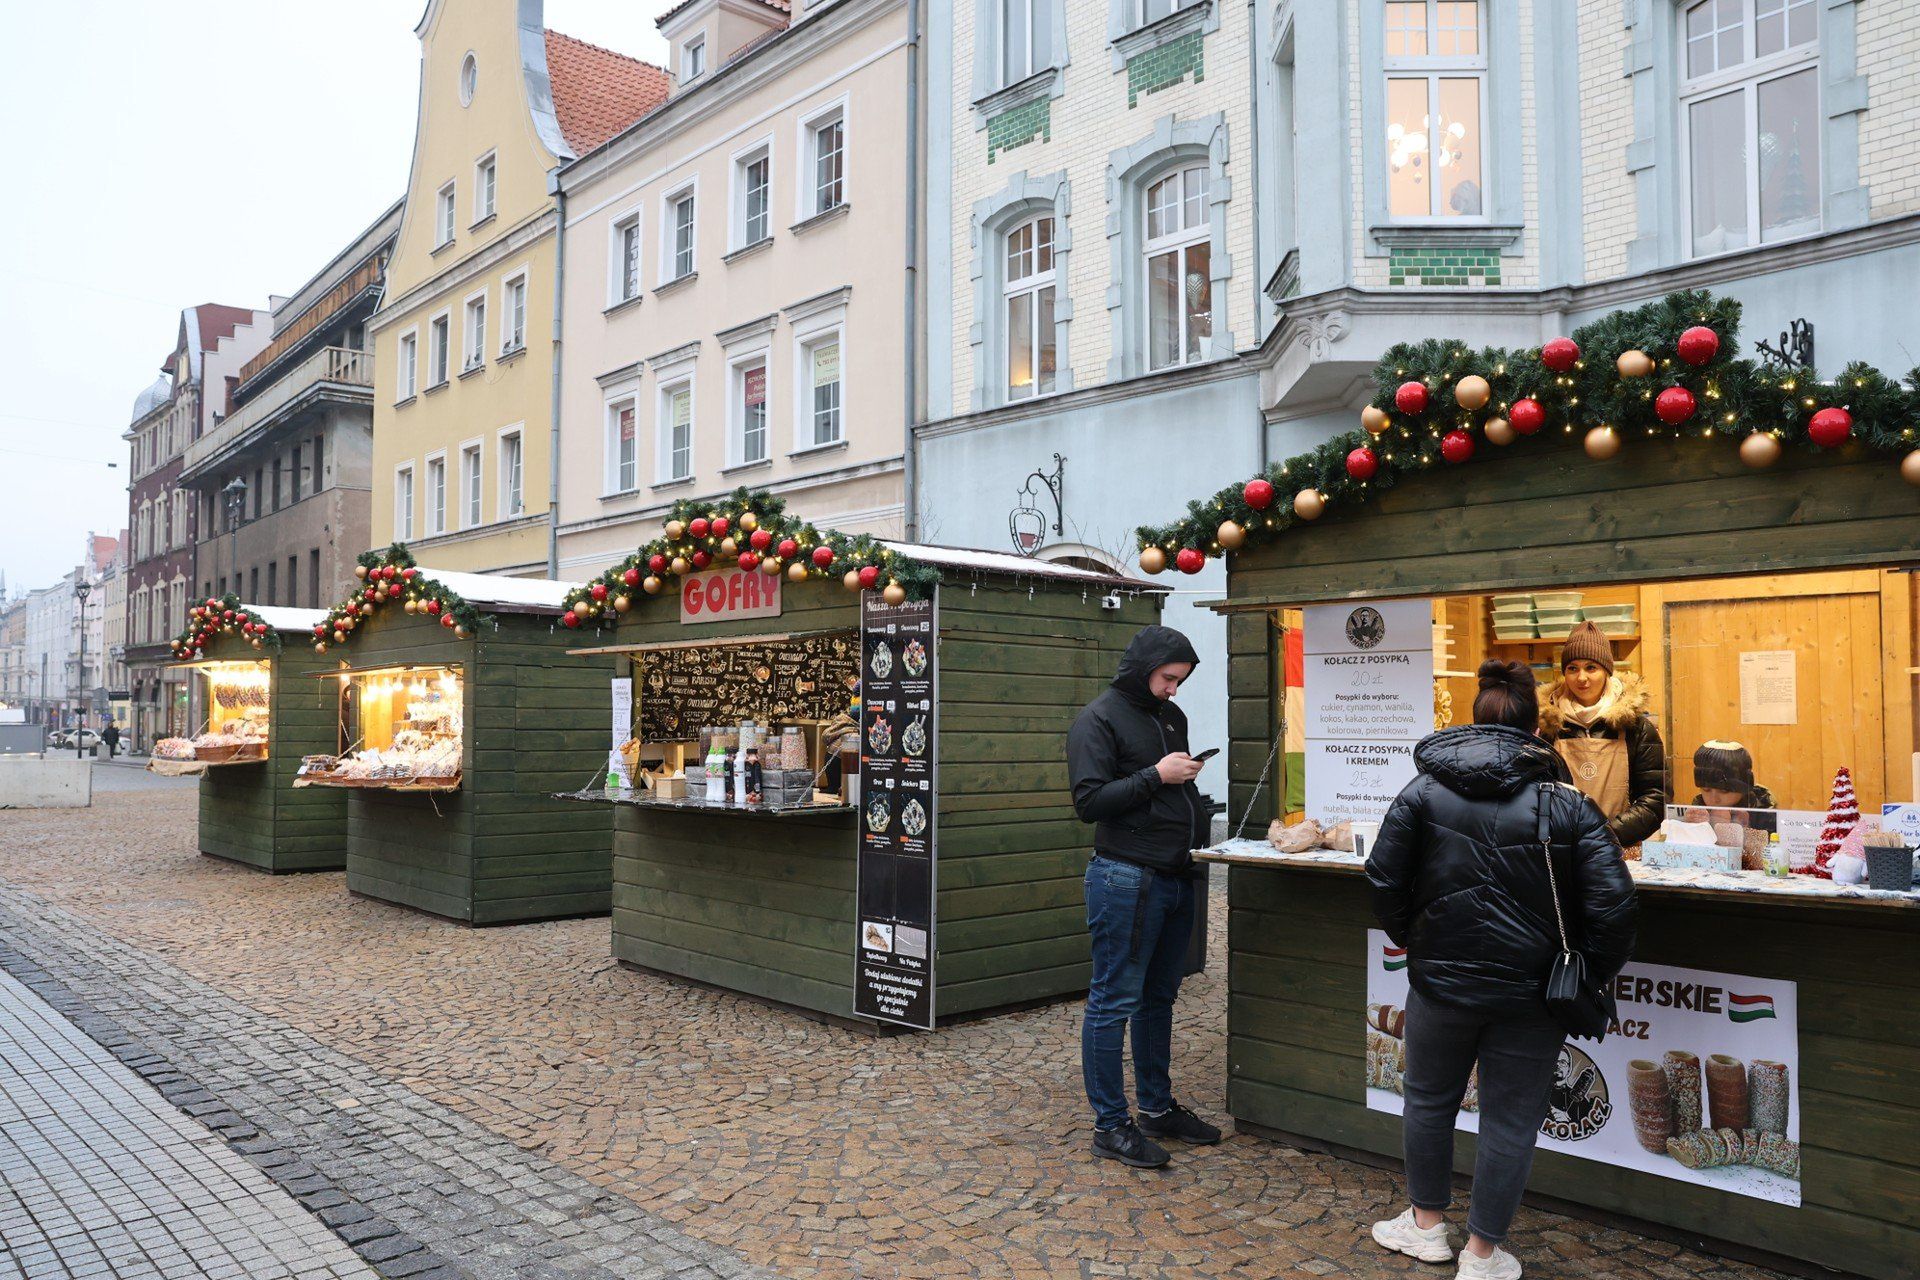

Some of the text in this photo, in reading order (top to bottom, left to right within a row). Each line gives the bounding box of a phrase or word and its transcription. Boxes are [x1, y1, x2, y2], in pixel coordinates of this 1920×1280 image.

[683, 571, 778, 615] GOFRY
[1324, 655, 1410, 665] KOŁACZ Z POSYPKĄ
[1351, 670, 1370, 687] 20
[1372, 693, 1399, 701] wyboru:
[1320, 703, 1415, 713] cukier, cynamon, wanilia,
[1320, 714, 1416, 723] kokos, kakao, orzechowa,
[1327, 726, 1408, 735] kolorowa, piernikowa
[1325, 745, 1411, 756] KOŁACZ Z POSYPKĄ
[1351, 757, 1389, 765] KREMEM
[1350, 770, 1369, 787] 25
[1336, 793, 1361, 801] Posypki
[1323, 805, 1351, 814] nutella,
[1541, 1098, 1612, 1140] KOŁACZ
